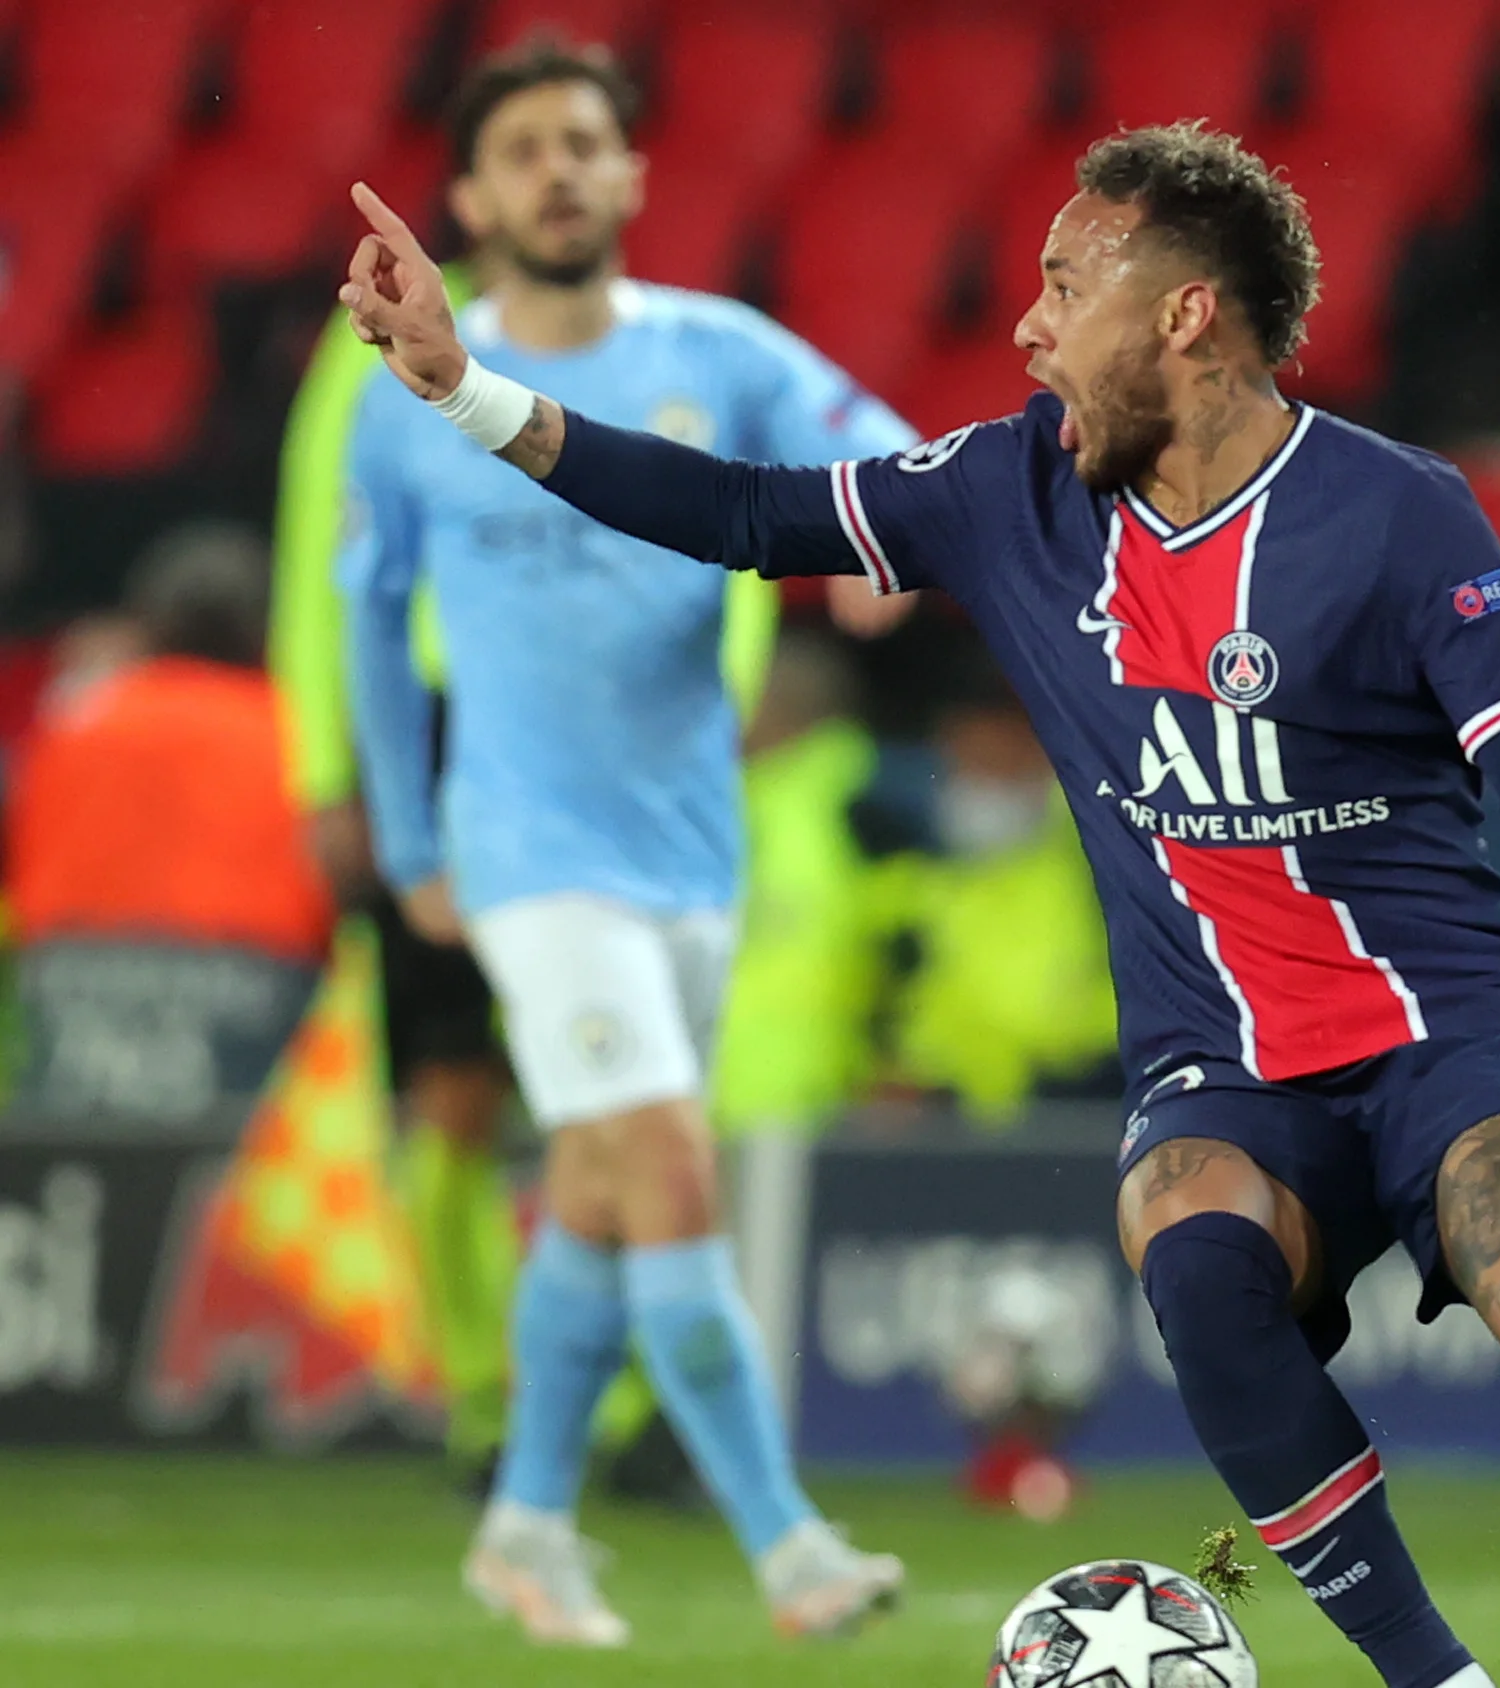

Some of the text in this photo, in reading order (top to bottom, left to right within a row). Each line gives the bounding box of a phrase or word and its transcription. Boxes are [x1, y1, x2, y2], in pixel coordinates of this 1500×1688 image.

[1161, 812, 1229, 841] LIVE
[1233, 797, 1389, 841] LIMITLESS
[1305, 1560, 1371, 1601] PARIS
